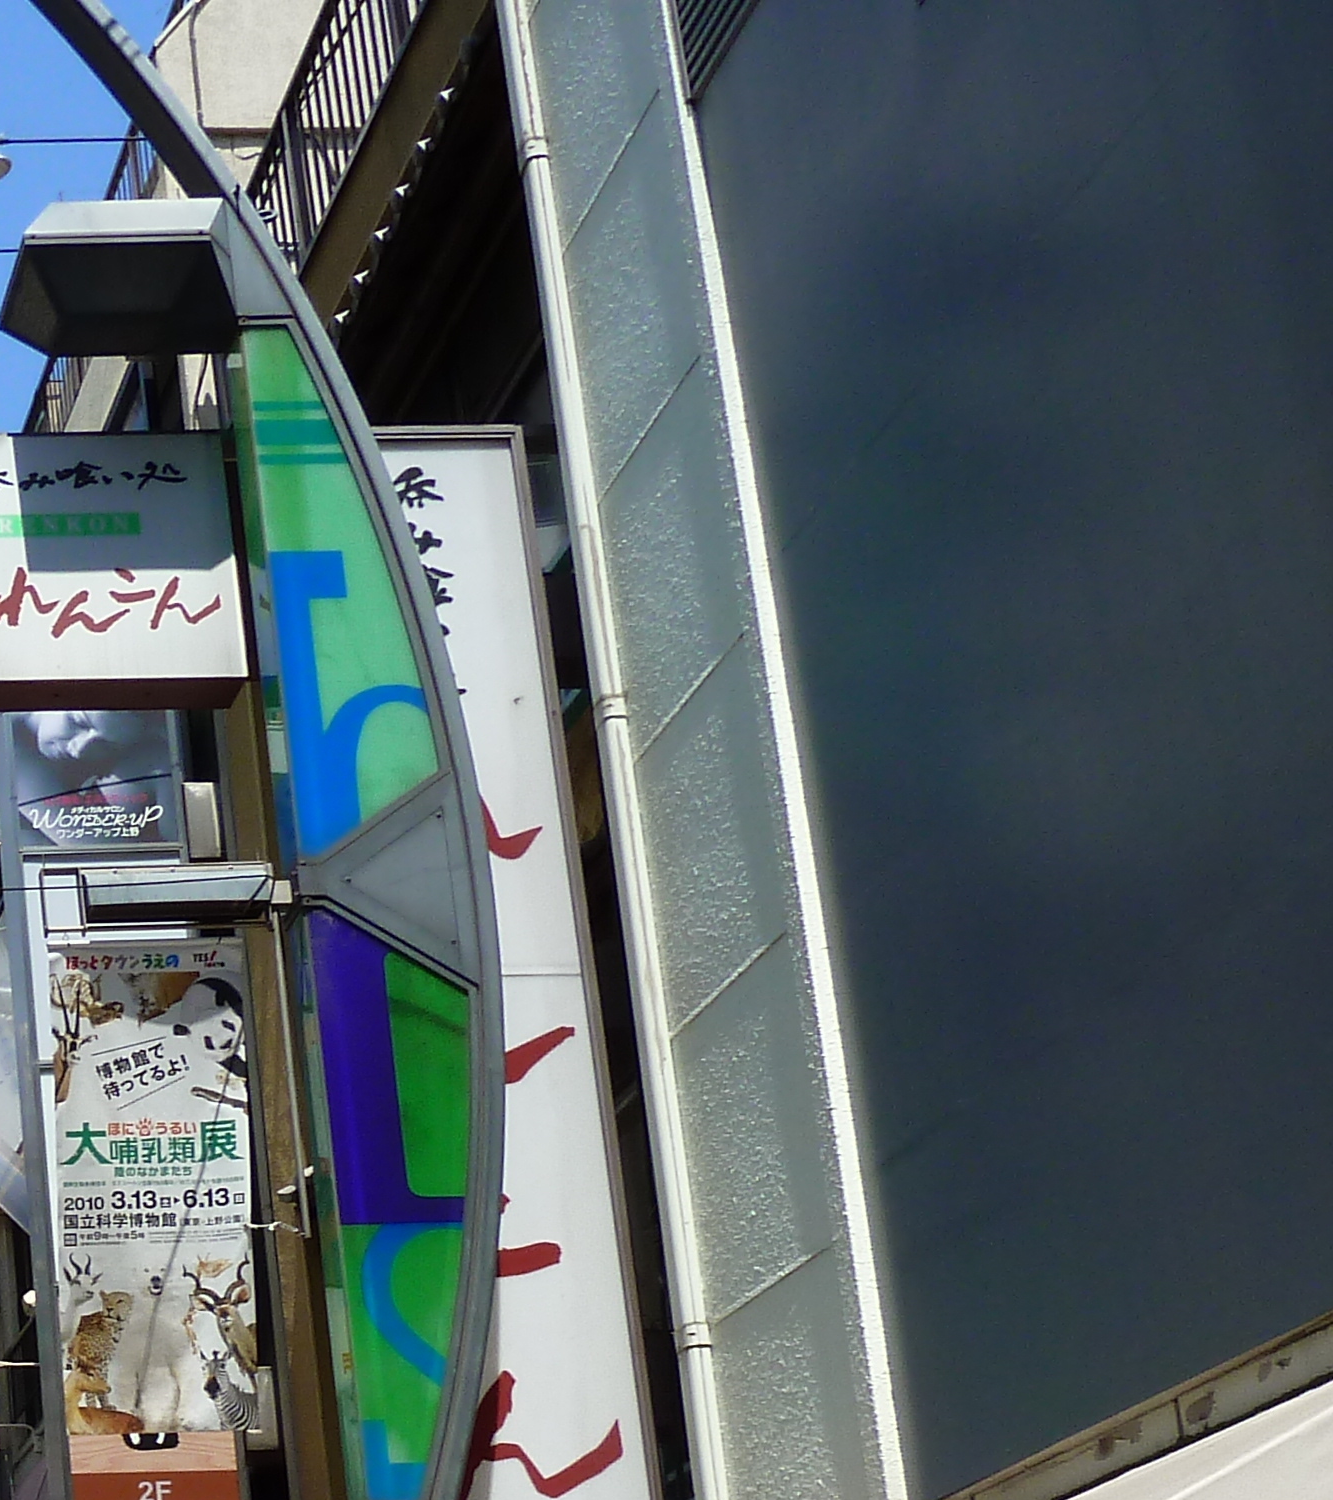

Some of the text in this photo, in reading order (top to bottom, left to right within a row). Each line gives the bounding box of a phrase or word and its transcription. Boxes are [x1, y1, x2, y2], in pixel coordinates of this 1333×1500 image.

[66, 954, 179, 970] ほっとタウンうえの
[96, 1043, 165, 1080] 博物館で
[102, 1054, 190, 1100] 待ってるよ!
[60, 1120, 244, 1165] 大哺乳類展
[64, 1197, 104, 1211] 2010
[111, 1190, 157, 1209] 3.13
[183, 1188, 230, 1208] 6.13
[63, 1212, 177, 1229] 国立科学博物館
